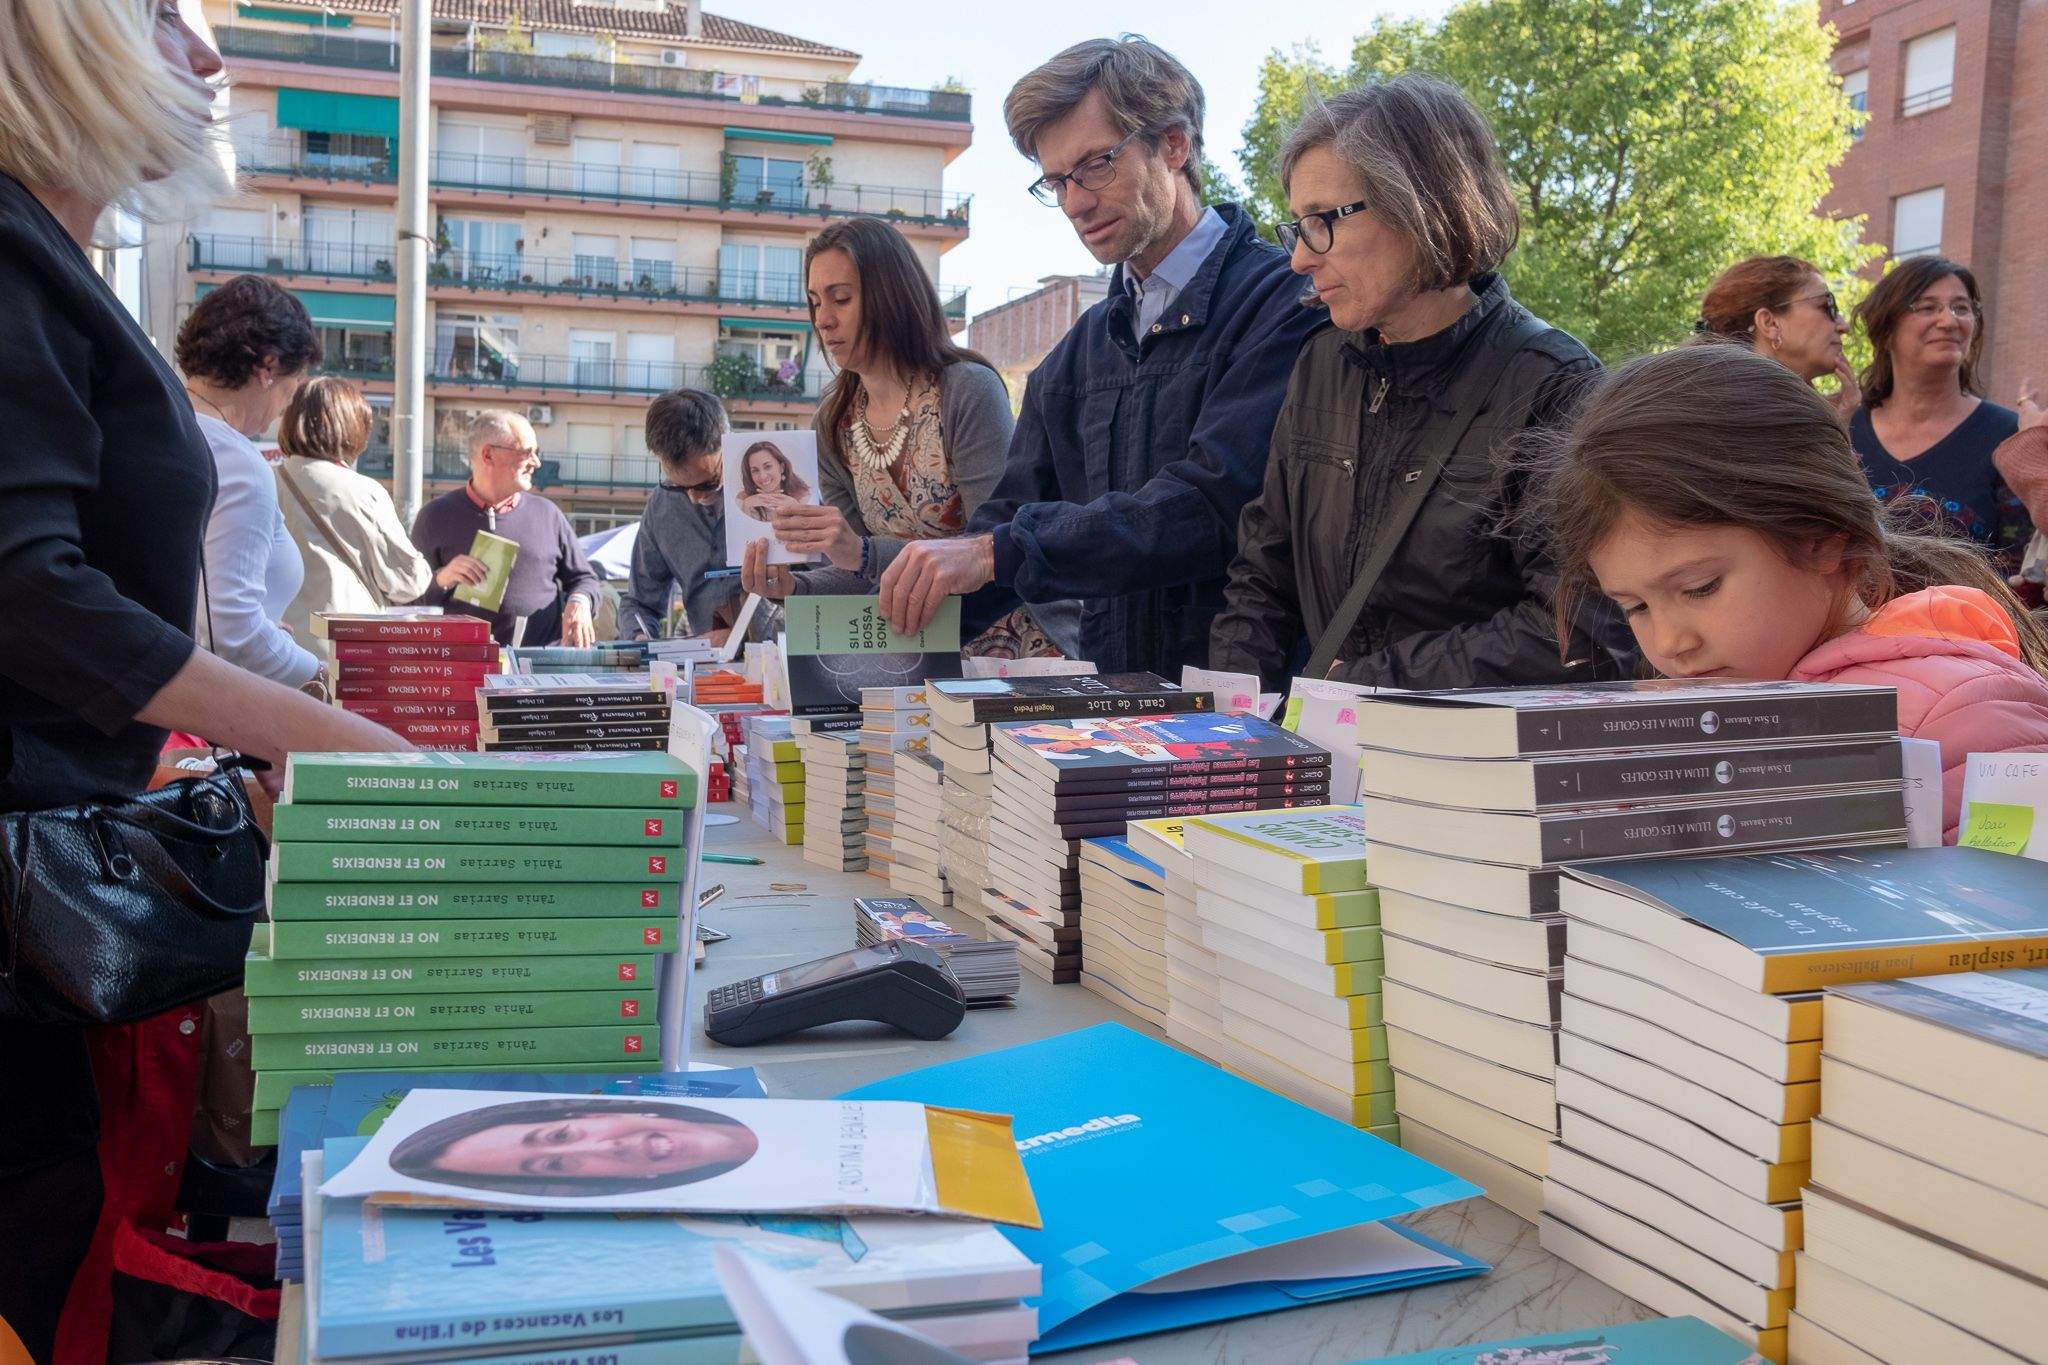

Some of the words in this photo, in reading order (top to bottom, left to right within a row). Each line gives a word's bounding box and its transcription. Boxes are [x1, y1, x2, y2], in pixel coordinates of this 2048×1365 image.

[380, 626, 411, 634] VERDAD
[849, 618, 859, 635] LA
[863, 606, 873, 649] BOSSA
[388, 646, 419, 654] VERDAD
[390, 666, 422, 674] VERDAD
[424, 666, 434, 674] LA
[388, 686, 420, 694] VERDAD
[422, 686, 432, 694] LA
[394, 706, 424, 714] VERDAD
[1034, 703, 1055, 712] Rogeli
[1087, 700, 1112, 712] llot
[1118, 700, 1132, 710] de
[1138, 698, 1166, 711] Camí
[1603, 720, 1640, 732] GOLFES
[1641, 719, 1658, 730] LES
[1659, 718, 1667, 729] A
[1668, 718, 1695, 728] LLUM
[1620, 770, 1657, 784] GOLFES
[1659, 769, 1674, 781] LES
[1675, 768, 1683, 780] A
[1684, 768, 1710, 779] LLUM
[1978, 764, 1998, 778] UN
[346, 776, 416, 789] RENDEIXIS
[419, 778, 434, 790] ET
[437, 779, 459, 790] NO
[473, 780, 528, 791] Sarrias
[326, 818, 396, 830] RENDEIXIS
[400, 819, 415, 830] ET
[419, 819, 441, 830] NO
[454, 819, 511, 831] Sarrias
[1661, 824, 1676, 836] LES
[1677, 822, 1686, 834] A
[1686, 821, 1712, 833] LLUM
[1624, 826, 1660, 841] GOLFES
[331, 857, 402, 869] RENDEIXIS
[405, 857, 420, 869] ET
[424, 858, 446, 869] NO
[459, 858, 516, 870] Sarrias
[325, 895, 395, 907] RENDEIXIS
[398, 894, 414, 906] ET
[417, 894, 439, 906] NO
[452, 894, 509, 906] Sarrias
[325, 933, 395, 945] RENDEIXIS
[399, 932, 414, 944] ET
[417, 932, 440, 943] NO
[454, 931, 510, 944] Sarrias
[1886, 954, 1916, 971] Joan
[1948, 946, 2016, 971] sisplau
[390, 968, 412, 980] NO
[426, 968, 483, 980] Sarrias
[1807, 960, 1880, 976] Ballesteros
[298, 969, 368, 982] RENDEIXIS
[371, 969, 387, 980] ET
[300, 1007, 371, 1020] RENDEIXIS
[374, 1006, 390, 1018] ET
[393, 1006, 415, 1017] NO
[429, 1005, 486, 1017] Sarrias
[304, 1043, 374, 1056] RENDEIXIS
[377, 1042, 393, 1054] ET
[396, 1042, 419, 1053] NO
[433, 1041, 489, 1053] Sarrias
[451, 1236, 497, 1268] Les
[493, 1312, 587, 1332] Vacances
[592, 1308, 624, 1325] Les
[461, 1320, 487, 1336] de
